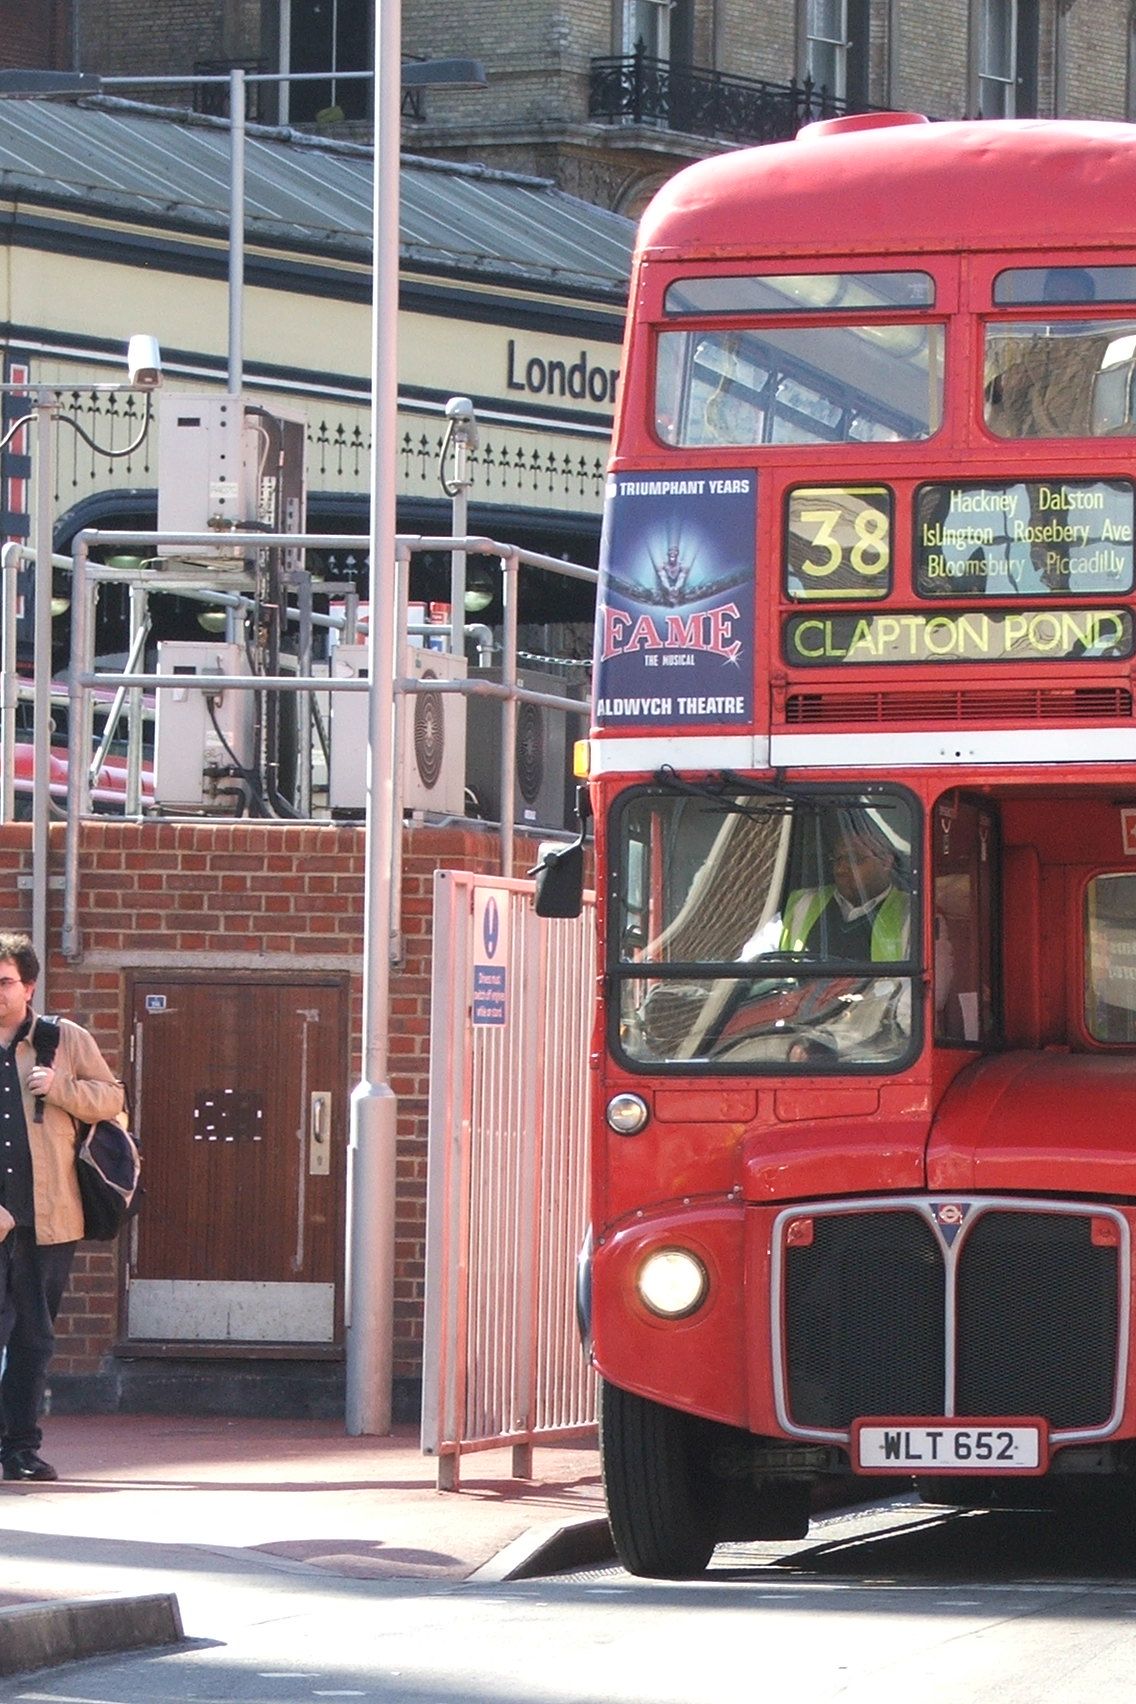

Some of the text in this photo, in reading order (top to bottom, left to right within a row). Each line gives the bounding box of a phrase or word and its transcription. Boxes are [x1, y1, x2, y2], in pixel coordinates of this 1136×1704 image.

[620, 480, 705, 496] TRIUMPHANT
[709, 479, 749, 495] YEARS
[950, 486, 1104, 517] Hackney Dalston
[799, 510, 890, 577] 38
[923, 518, 1132, 548] Islington Rosebery Ave
[927, 551, 1125, 581] Bloomsbury Piccadilly
[598, 602, 742, 662] FAME
[794, 611, 1124, 657] CLAPTON POND
[644, 653, 695, 667] THE MUSICAL
[597, 697, 744, 716] ALDWYCH THEATRE
[883, 1431, 1014, 1461] WLT 652
